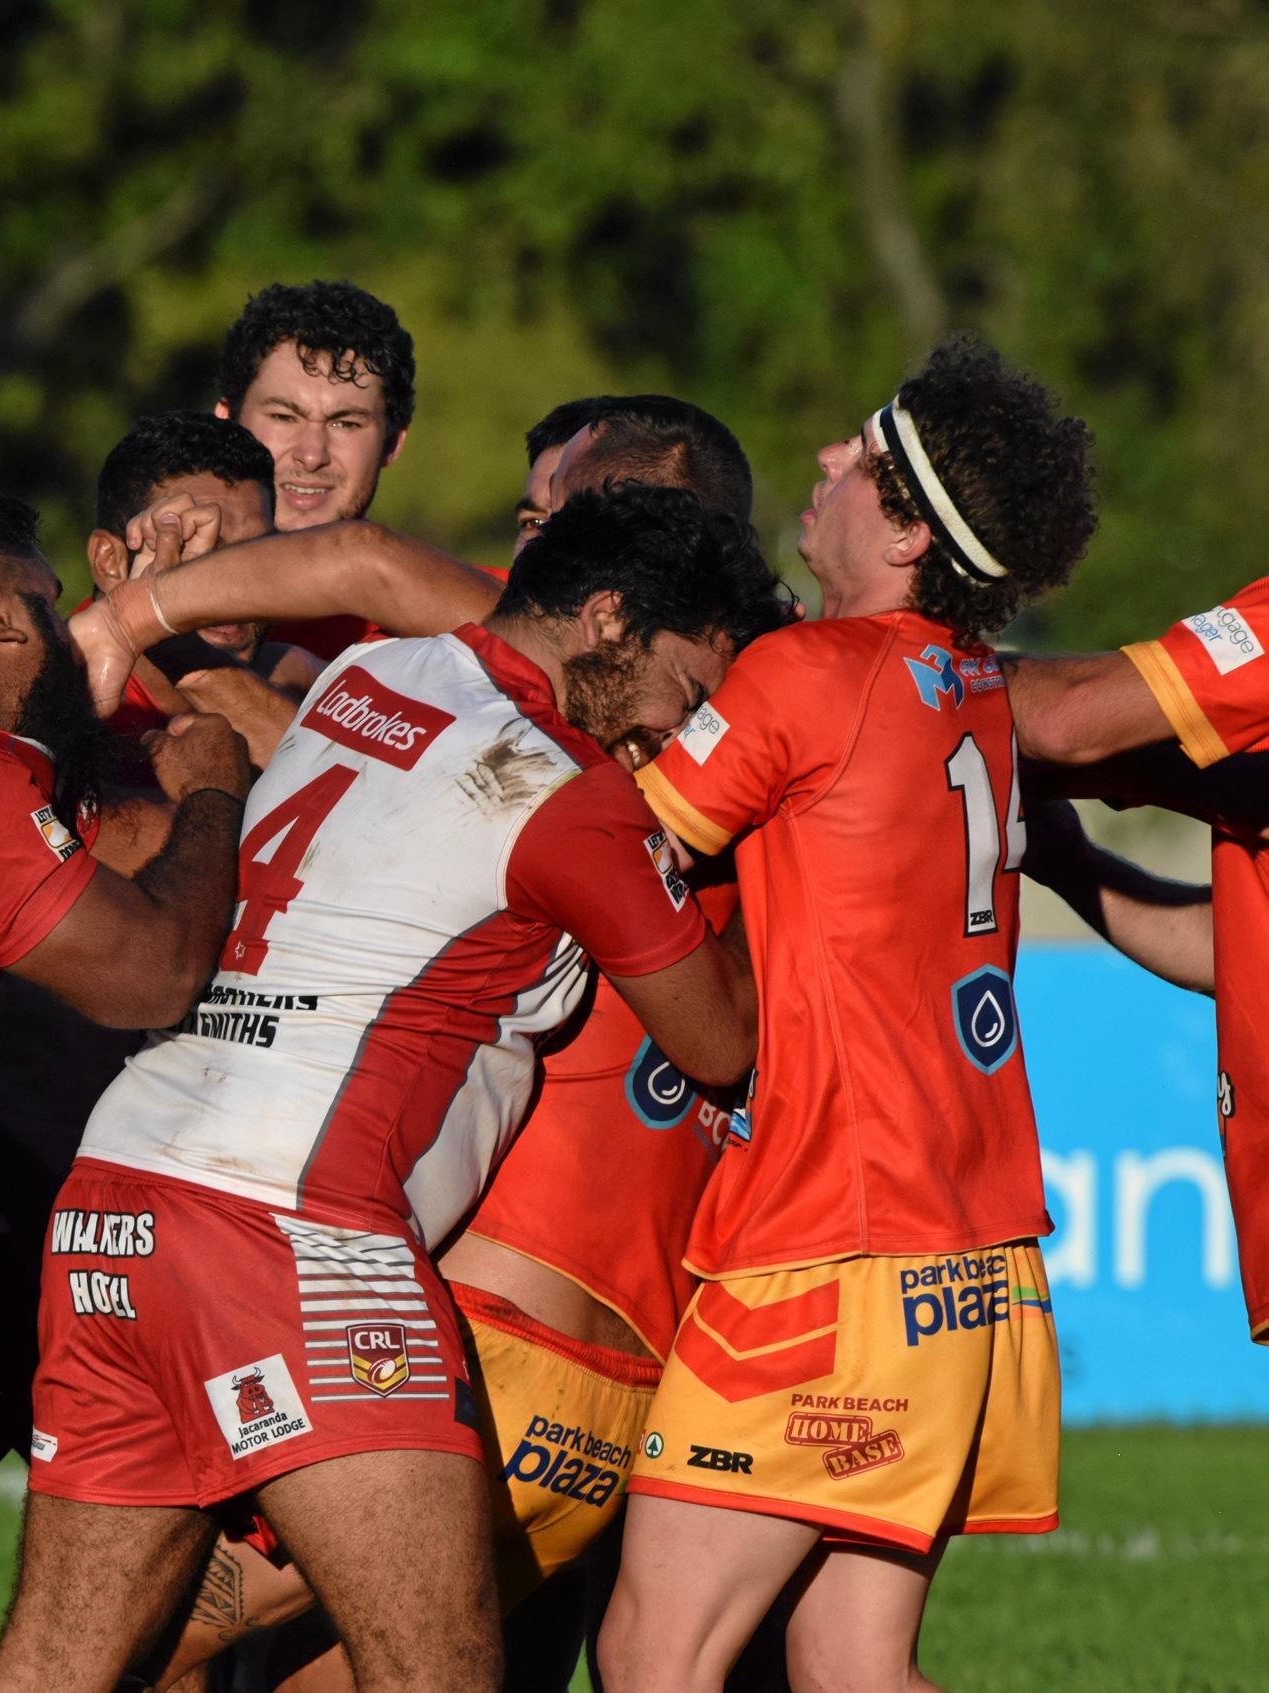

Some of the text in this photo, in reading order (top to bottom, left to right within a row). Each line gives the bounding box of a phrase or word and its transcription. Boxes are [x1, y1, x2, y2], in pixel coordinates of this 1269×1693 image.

[317, 679, 427, 751] Ladbrokes
[219, 763, 360, 976] 4
[970, 909, 994, 927] ZBR
[900, 1258, 964, 1294] park
[354, 1331, 400, 1350] CRL
[791, 1393, 909, 1412] PARK BEACH
[231, 1418, 306, 1454] MOTOR LODGE
[238, 1411, 288, 1438] Jacaranda
[525, 1414, 585, 1452] park
[583, 1430, 632, 1469] beach
[790, 1418, 868, 1443] HOME
[497, 1438, 620, 1509] plaza
[687, 1444, 754, 1475] ZBR
[829, 1437, 899, 1475] BASE
